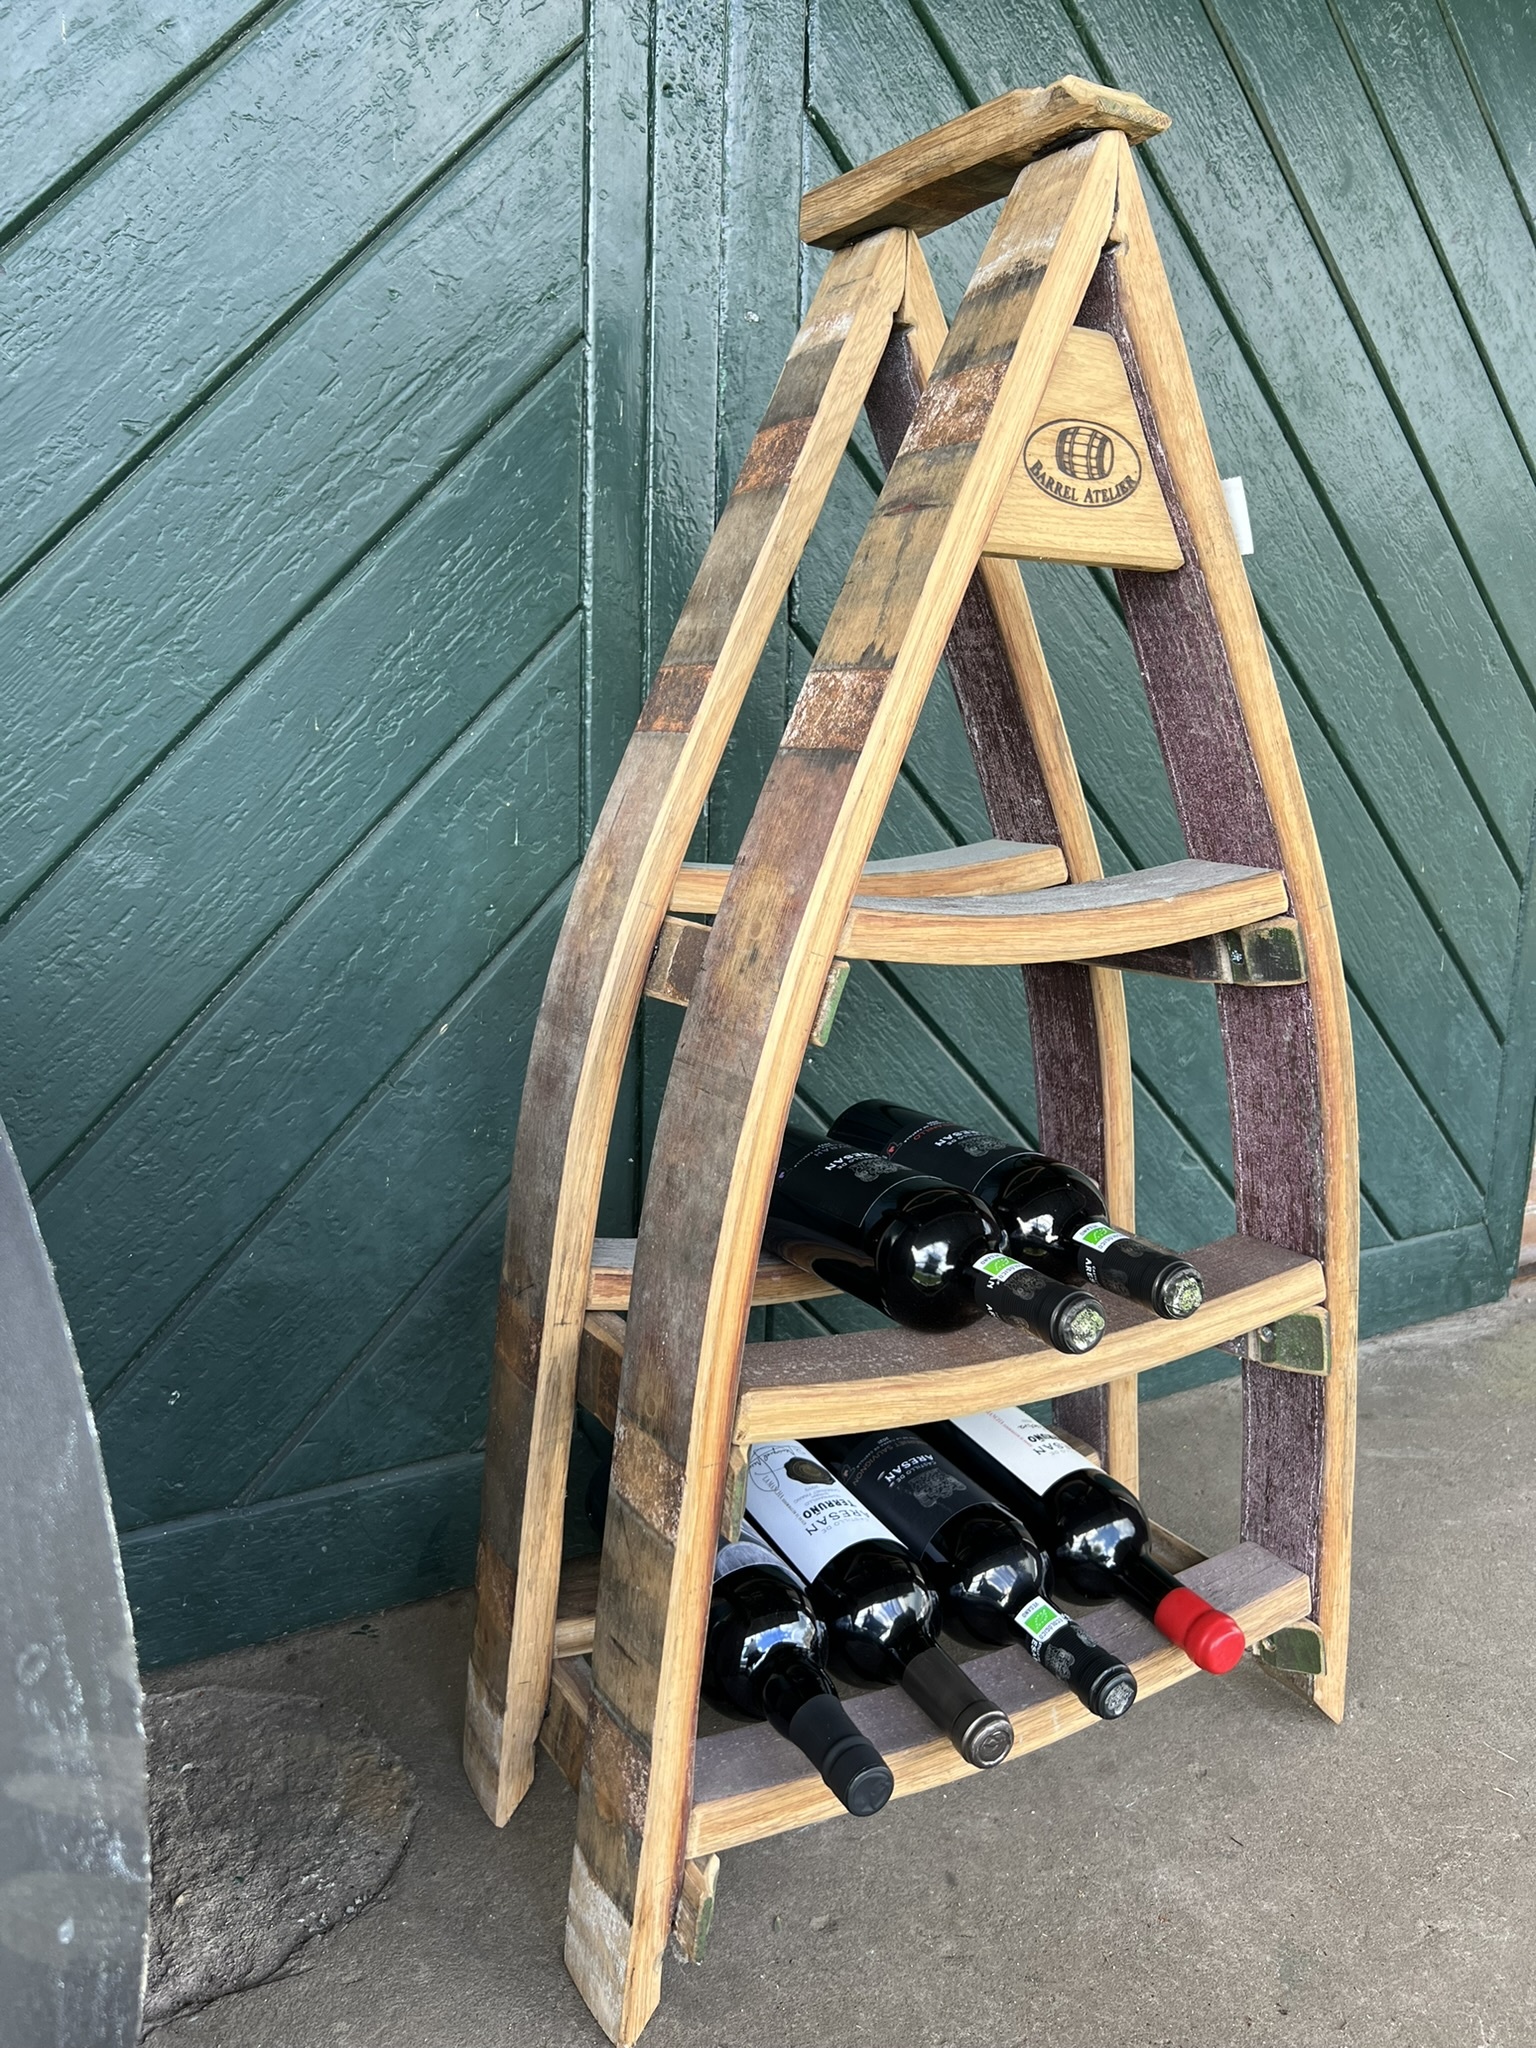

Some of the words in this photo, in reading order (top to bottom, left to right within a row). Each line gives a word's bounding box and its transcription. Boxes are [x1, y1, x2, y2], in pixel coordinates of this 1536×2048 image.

[1029, 459, 1079, 502] BARREL
[1083, 474, 1138, 504] ATELIER
[1084, 1257, 1097, 1284] ARES
[884, 1453, 935, 1483] ARESAN
[802, 1498, 857, 1519] TERRUÑO
[805, 1509, 871, 1537] ARESAN
[1021, 1601, 1040, 1619] VEGANO
